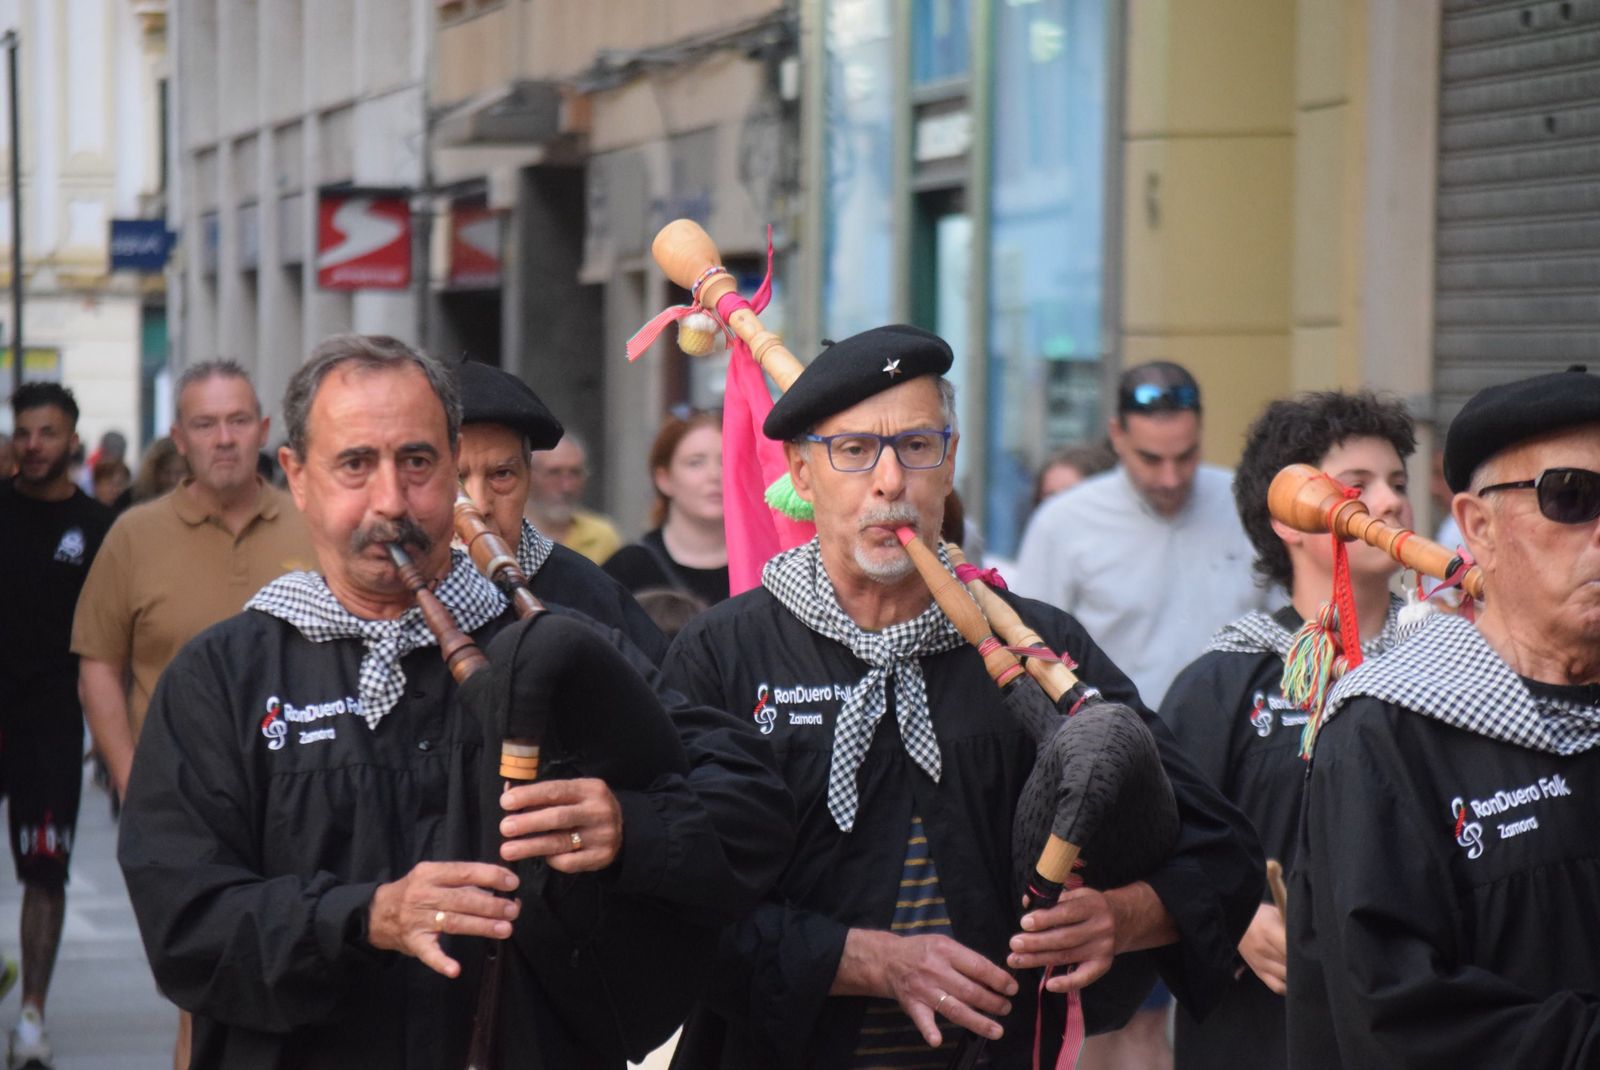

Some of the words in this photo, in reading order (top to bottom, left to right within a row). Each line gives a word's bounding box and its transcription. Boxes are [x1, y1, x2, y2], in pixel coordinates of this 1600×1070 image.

[774, 686, 832, 704] RonDuero
[283, 699, 346, 723] RonDuero
[345, 696, 365, 716] Fol
[788, 712, 823, 725] Zamora
[1470, 784, 1541, 819] RonDuero
[1538, 773, 1572, 799] Folk
[1496, 816, 1539, 839] Zamora
